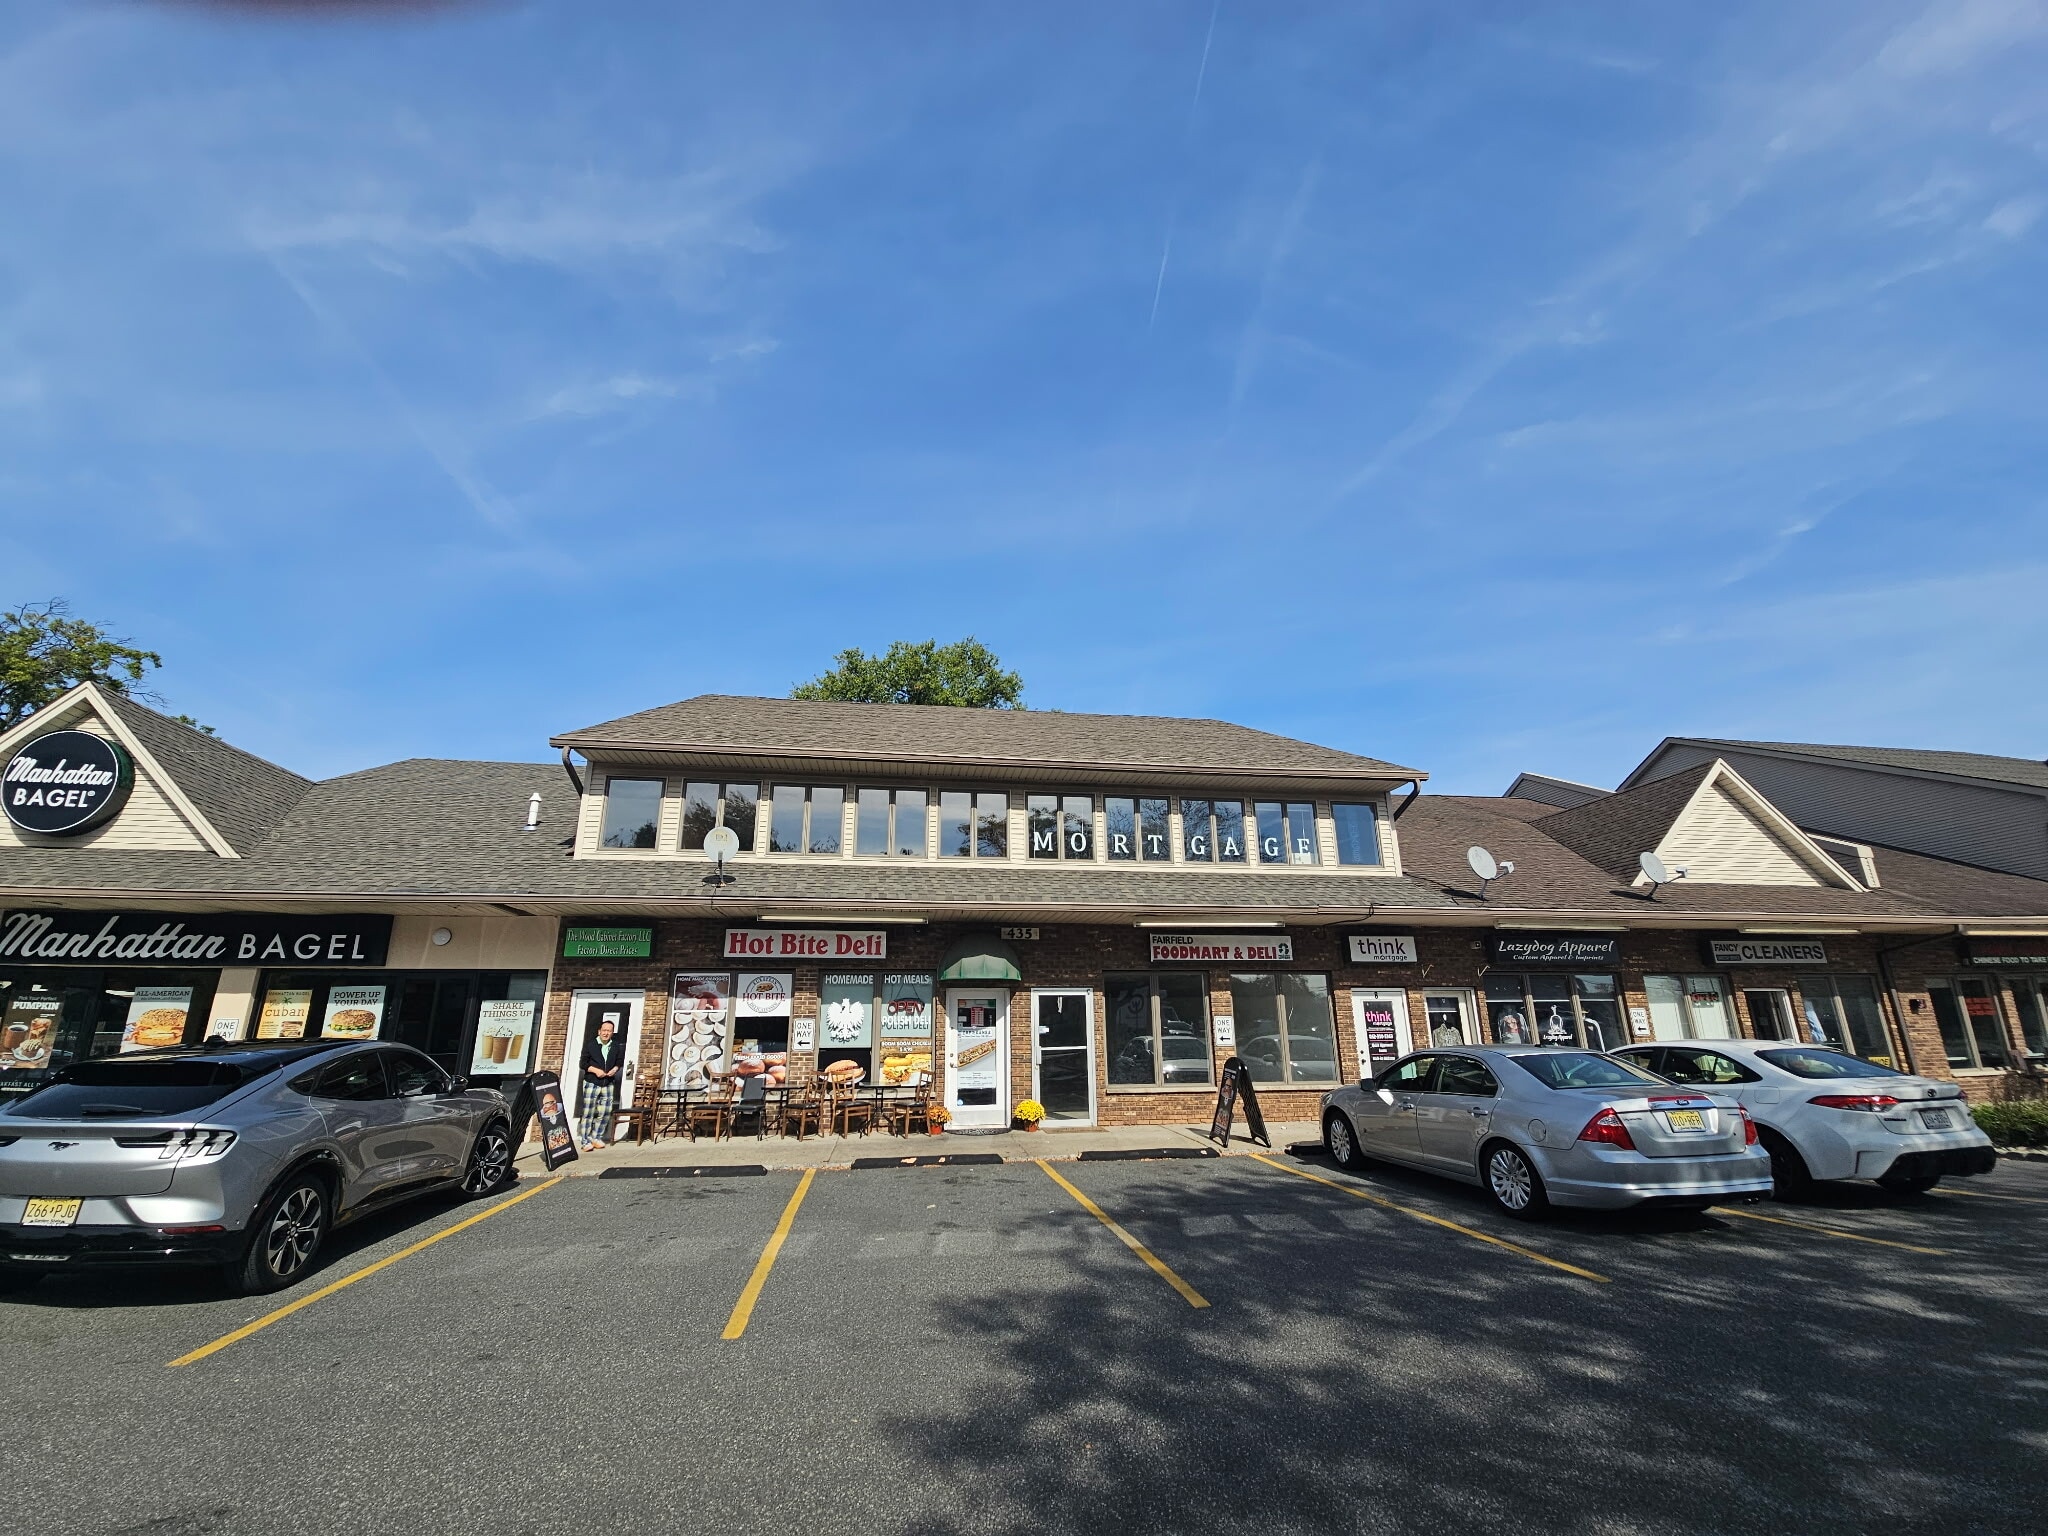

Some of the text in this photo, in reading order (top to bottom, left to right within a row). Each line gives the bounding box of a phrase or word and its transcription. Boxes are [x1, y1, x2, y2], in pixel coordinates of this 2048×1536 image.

[6, 757, 113, 785] Manhattan
[0, 913, 365, 960] Manhattan BAGEL
[1007, 928, 1032, 939] 435
[728, 932, 882, 955] Hot Bite Deli
[1152, 936, 1194, 944] FAIRFIELD
[577, 944, 637, 956] Factory Direct Prices
[1357, 938, 1406, 954] think
[1498, 940, 1614, 955] Lazydog Apparel
[1714, 943, 1738, 952] FANCY
[1153, 946, 1276, 959] FOODMART & DELI
[1741, 945, 1824, 960] CLEANERS
[825, 974, 874, 985] HOMEMADE
[884, 974, 930, 985] HOT MEALS
[334, 991, 366, 999] POWER
[742, 992, 786, 1002] HOT BITE
[12, 1001, 60, 1010] PUMPKIN
[492, 1002, 524, 1010] SHAKE
[887, 1000, 926, 1016] OPEN
[265, 1006, 305, 1017] cuban
[483, 1010, 518, 1018] THINGS
[1366, 1011, 1392, 1022] think
[217, 1022, 235, 1030] ONE
[797, 1022, 812, 1030] ONE
[881, 1015, 931, 1026] POLISH DELI
[797, 1030, 812, 1038] WAY
